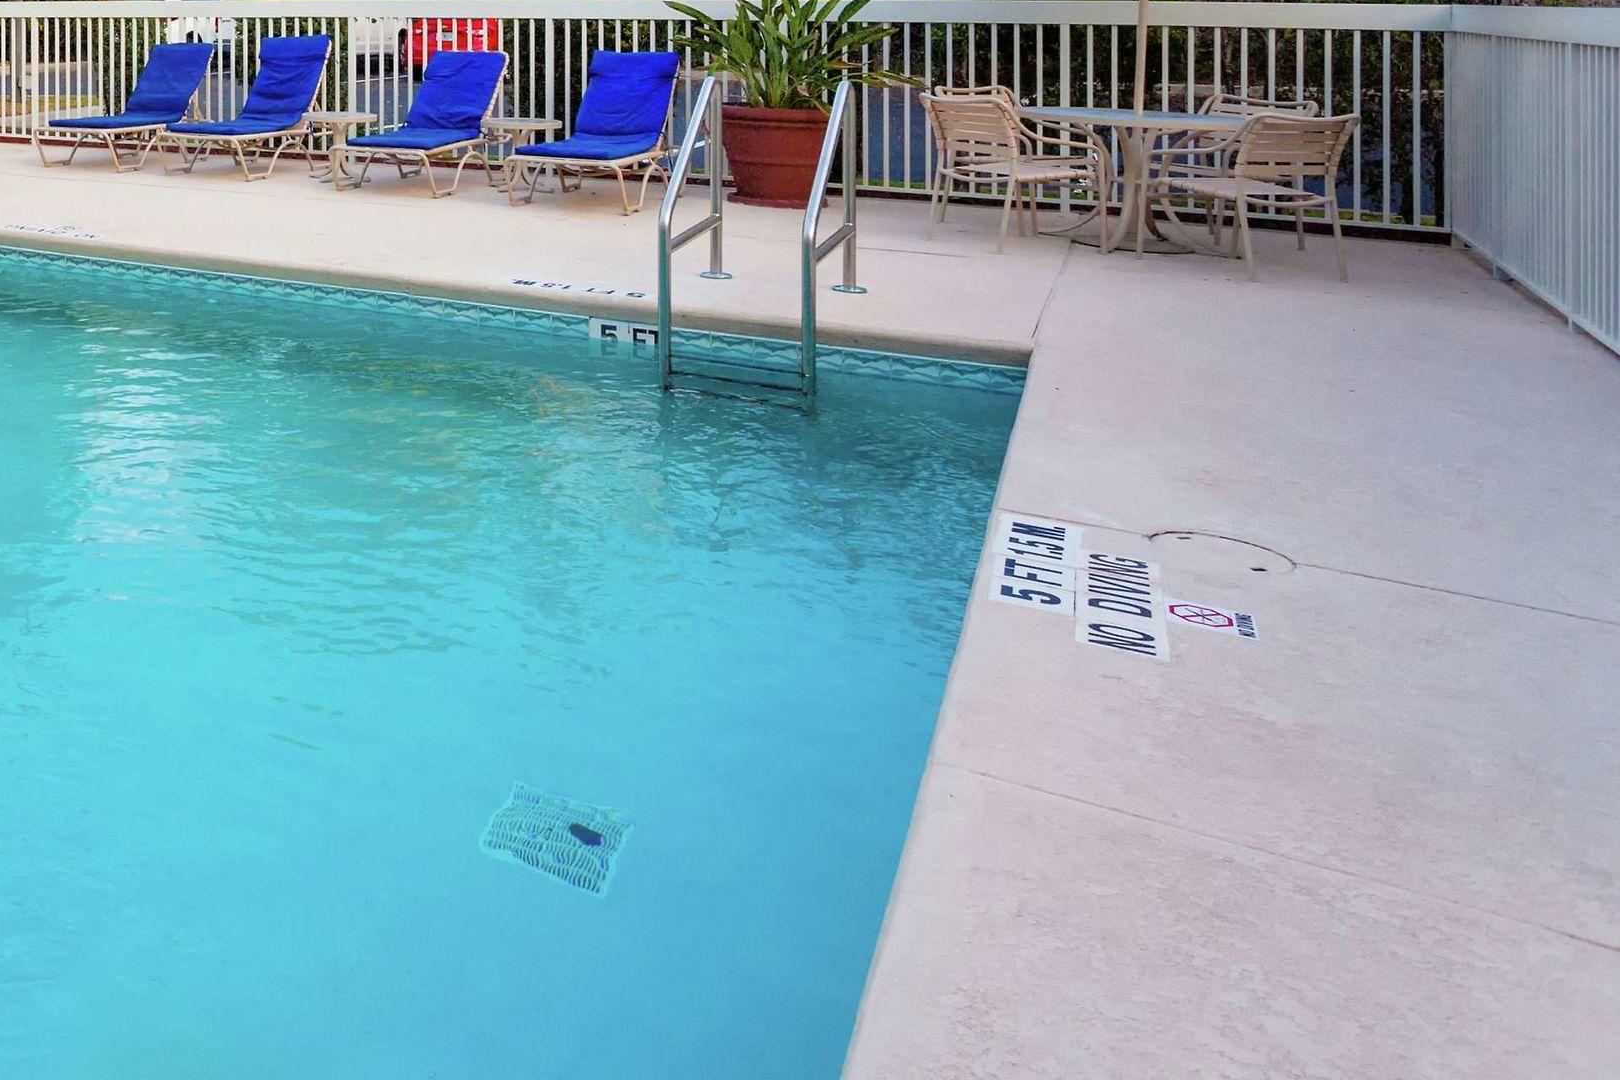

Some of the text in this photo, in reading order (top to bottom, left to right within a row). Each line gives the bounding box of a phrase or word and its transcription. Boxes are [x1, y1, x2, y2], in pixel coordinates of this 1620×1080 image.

[601, 324, 618, 343] 5
[1007, 537, 1065, 561] 1.5
[1003, 558, 1063, 587] FT
[1000, 584, 1062, 606] 5
[1088, 553, 1157, 656] NO DIVING
